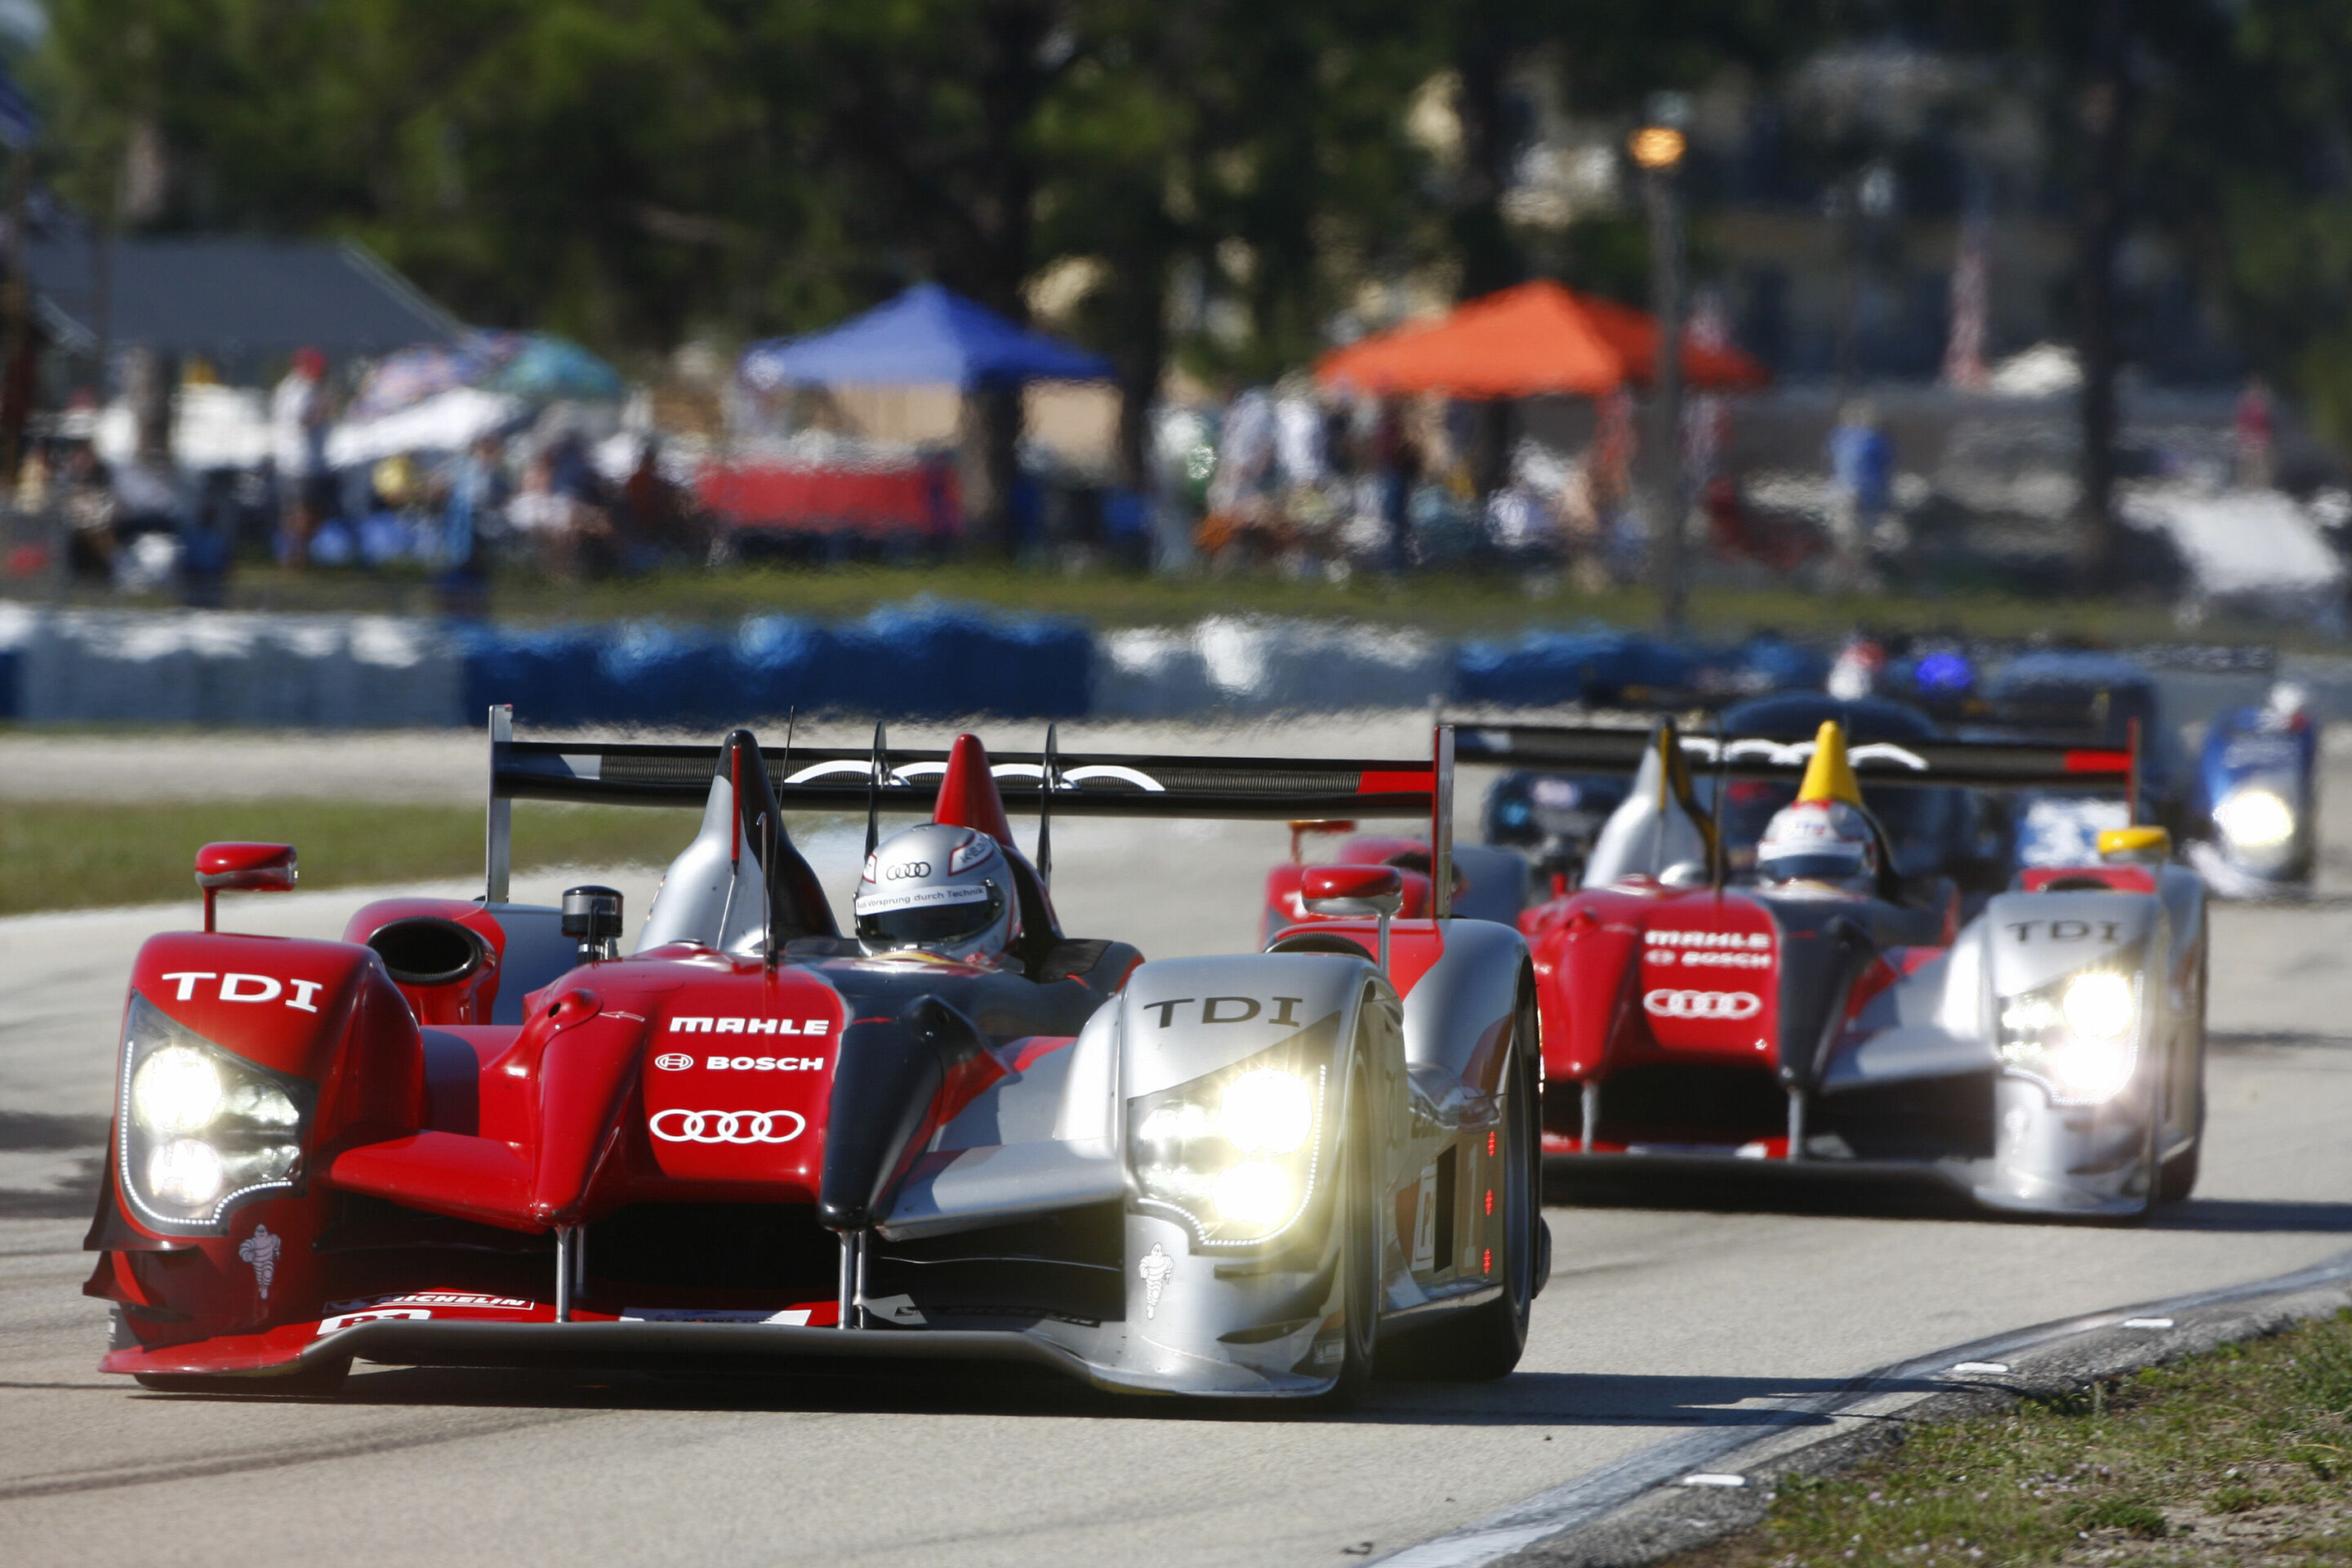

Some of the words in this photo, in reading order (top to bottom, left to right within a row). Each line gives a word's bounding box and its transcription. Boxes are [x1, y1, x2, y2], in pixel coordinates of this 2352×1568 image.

[867, 897, 911, 908] Vorsprung
[914, 892, 945, 902] durch
[947, 887, 985, 898] Technik
[1645, 929, 1771, 950] MAHLE
[2005, 919, 2124, 943] TDI
[1680, 951, 1773, 969] BOSCH
[162, 972, 323, 1013] TDI
[1143, 996, 1303, 1028] TDI
[669, 1017, 830, 1036] MAHLE
[706, 1055, 825, 1071] BOSCH
[375, 1294, 527, 1307] MICHELIN
